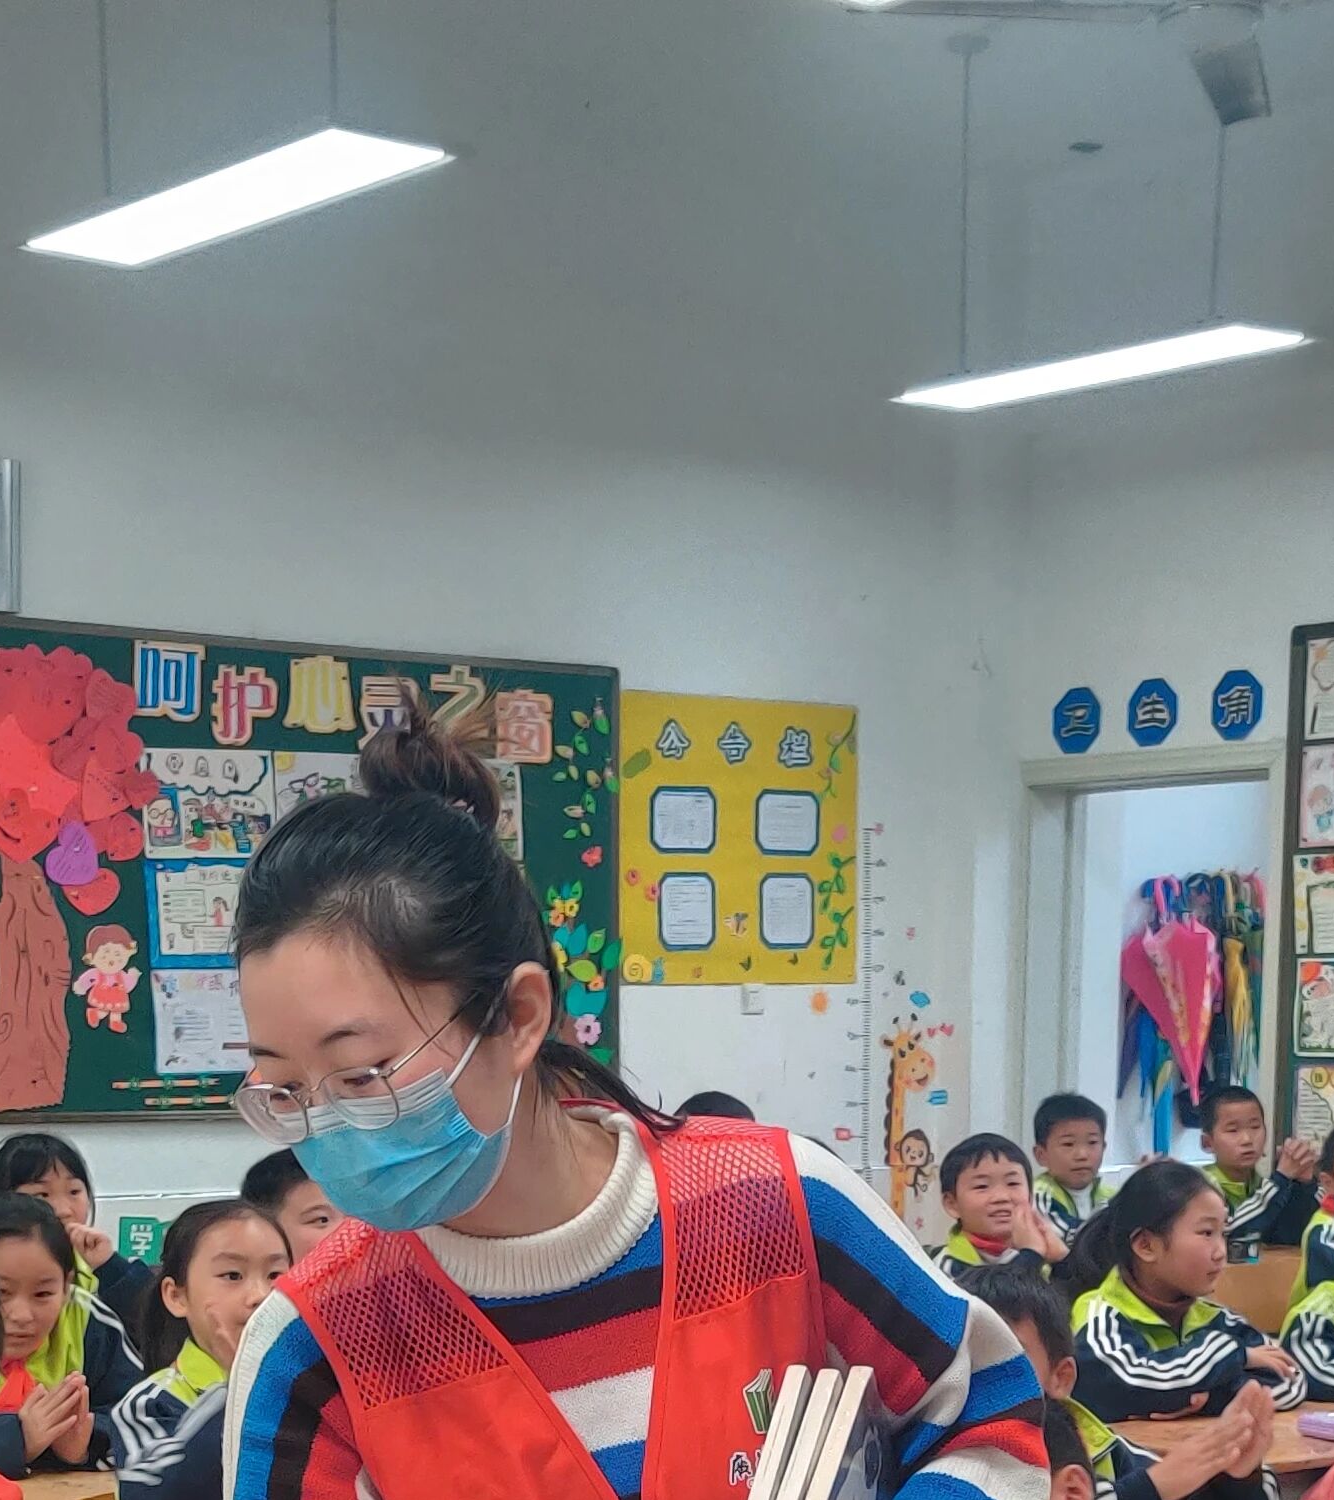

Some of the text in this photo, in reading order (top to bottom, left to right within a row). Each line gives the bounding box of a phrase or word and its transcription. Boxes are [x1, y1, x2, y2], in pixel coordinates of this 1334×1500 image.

[1059, 684, 1254, 738] 卫生角
[655, 718, 814, 769] 公告栏
